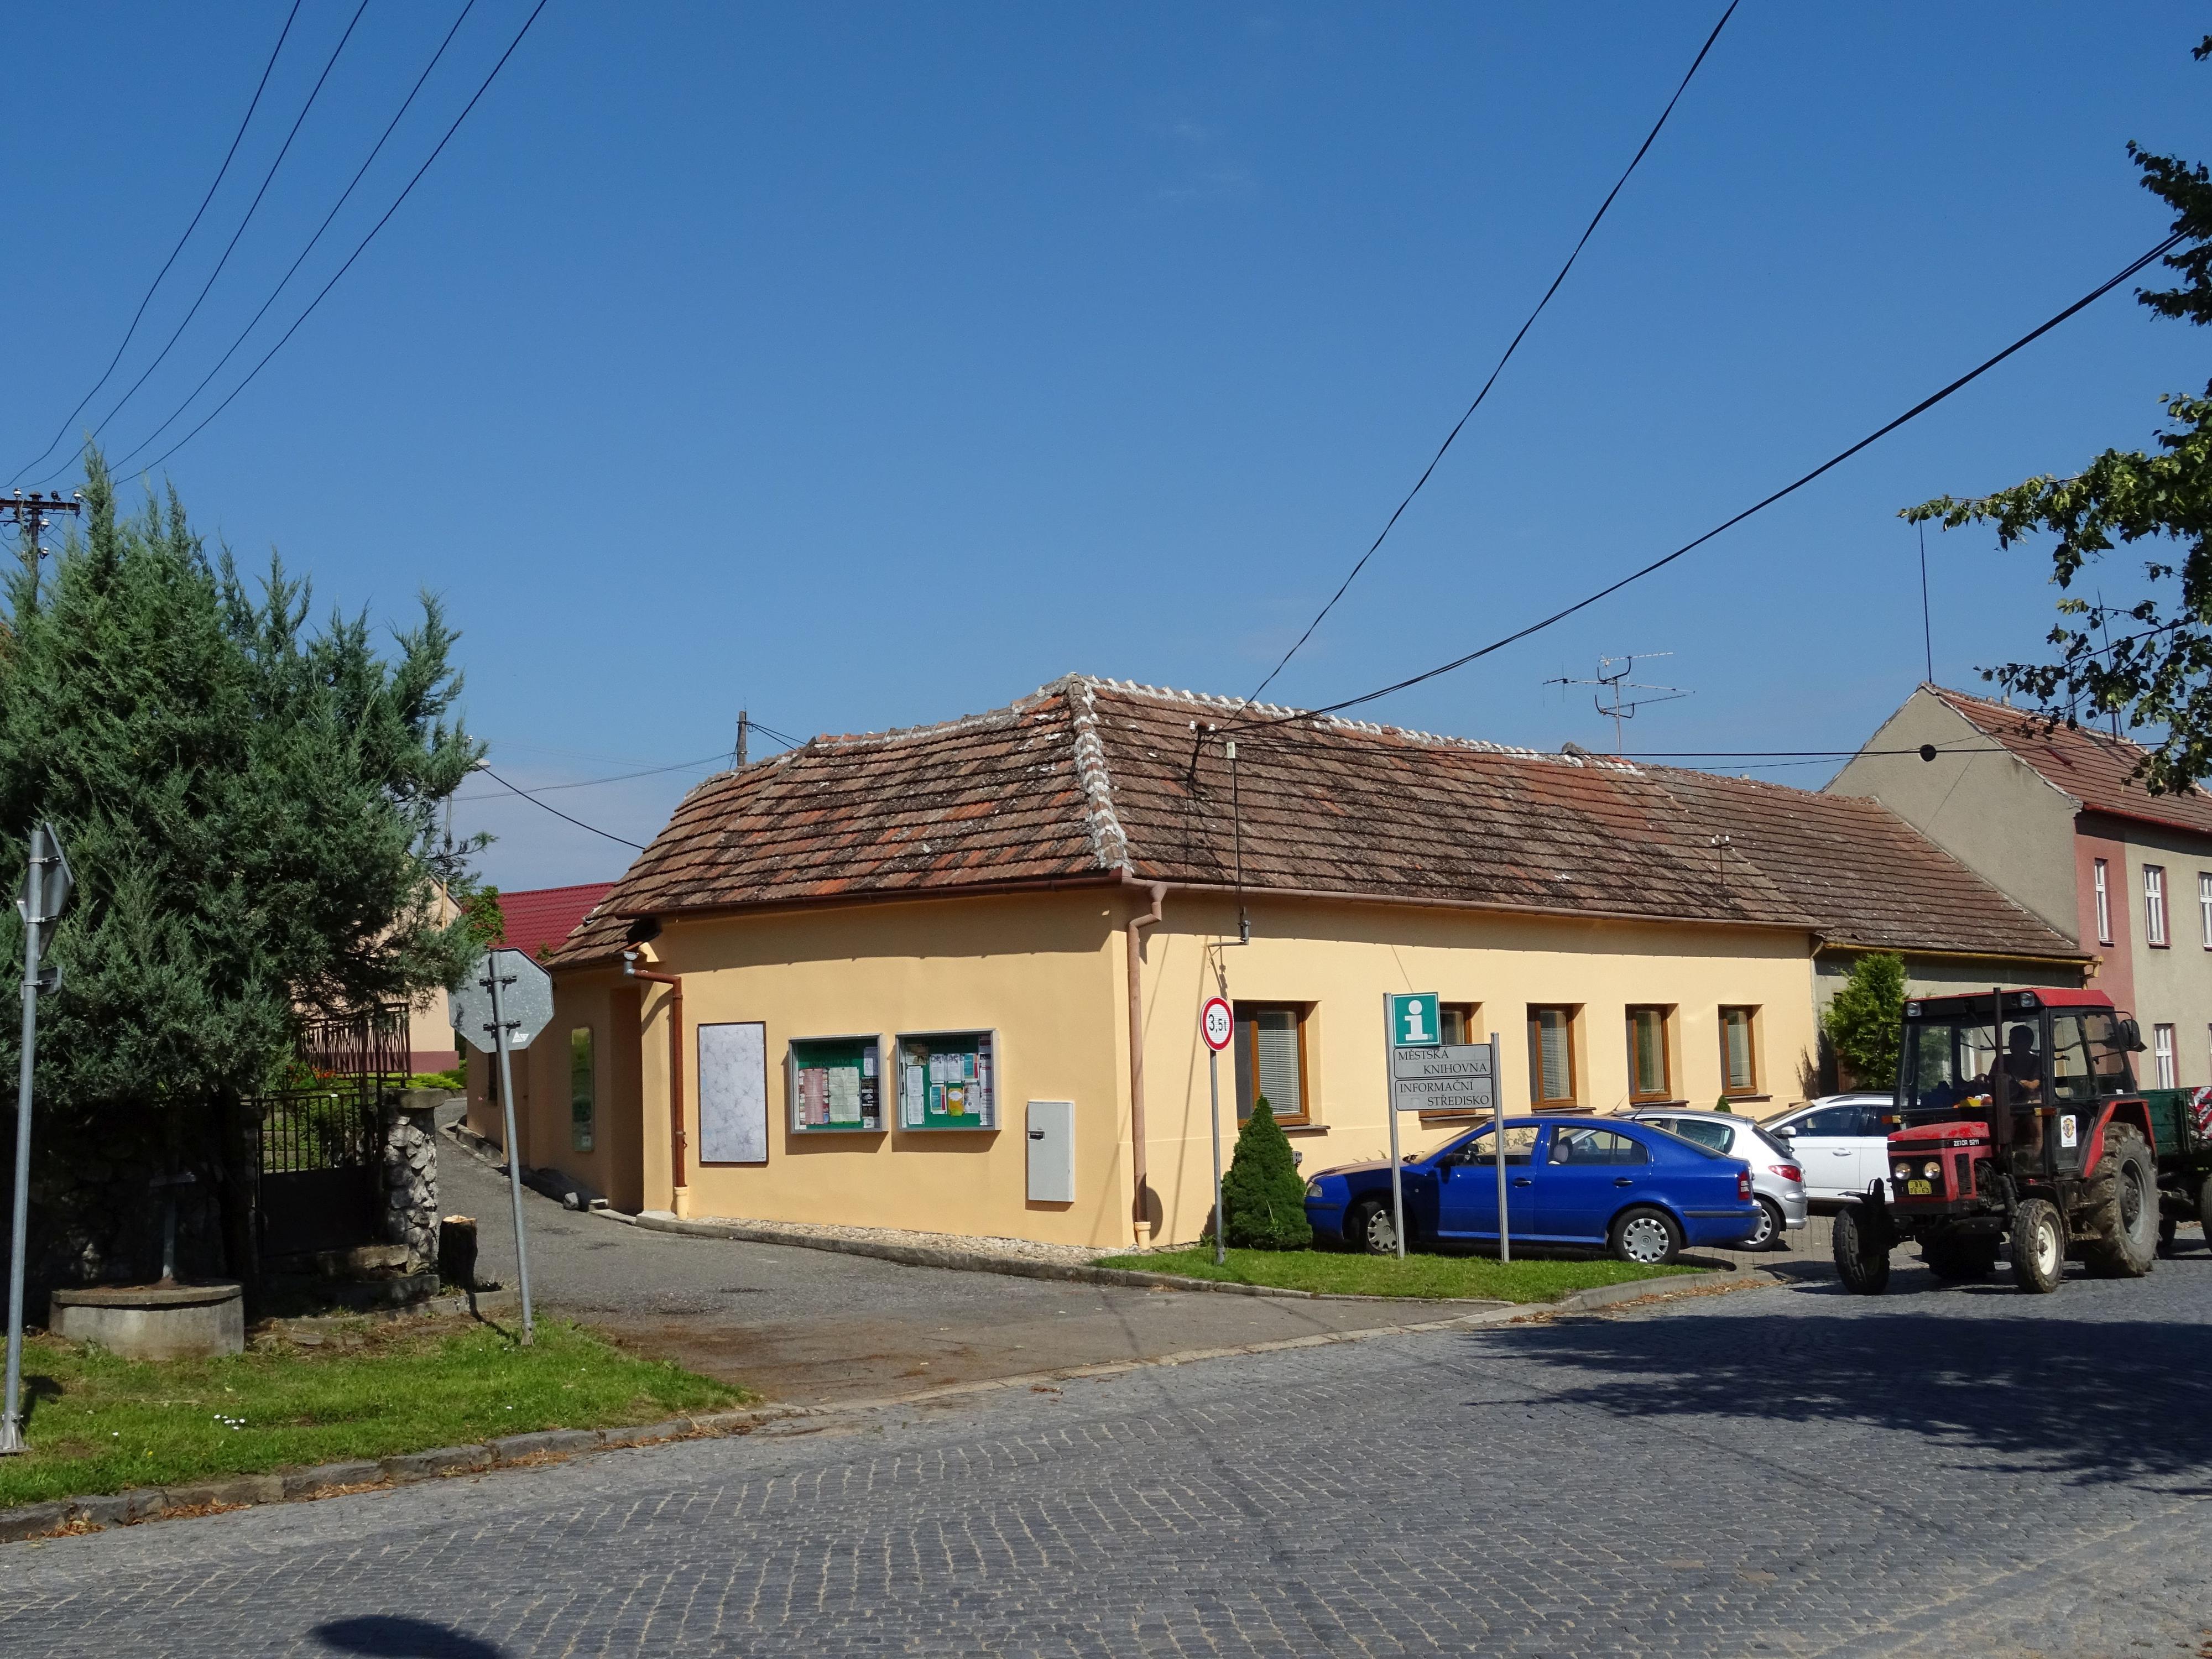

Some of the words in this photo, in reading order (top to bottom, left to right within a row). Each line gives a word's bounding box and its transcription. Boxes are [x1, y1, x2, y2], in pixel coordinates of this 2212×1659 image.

[1398, 1047, 1449, 1061] MĚSTSKÁ
[1423, 1063, 1488, 1074] KNIHOVNA
[1400, 1079, 1474, 1093] INFORMAČNÍ
[1427, 1094, 1489, 1106] STŘEDISKO
